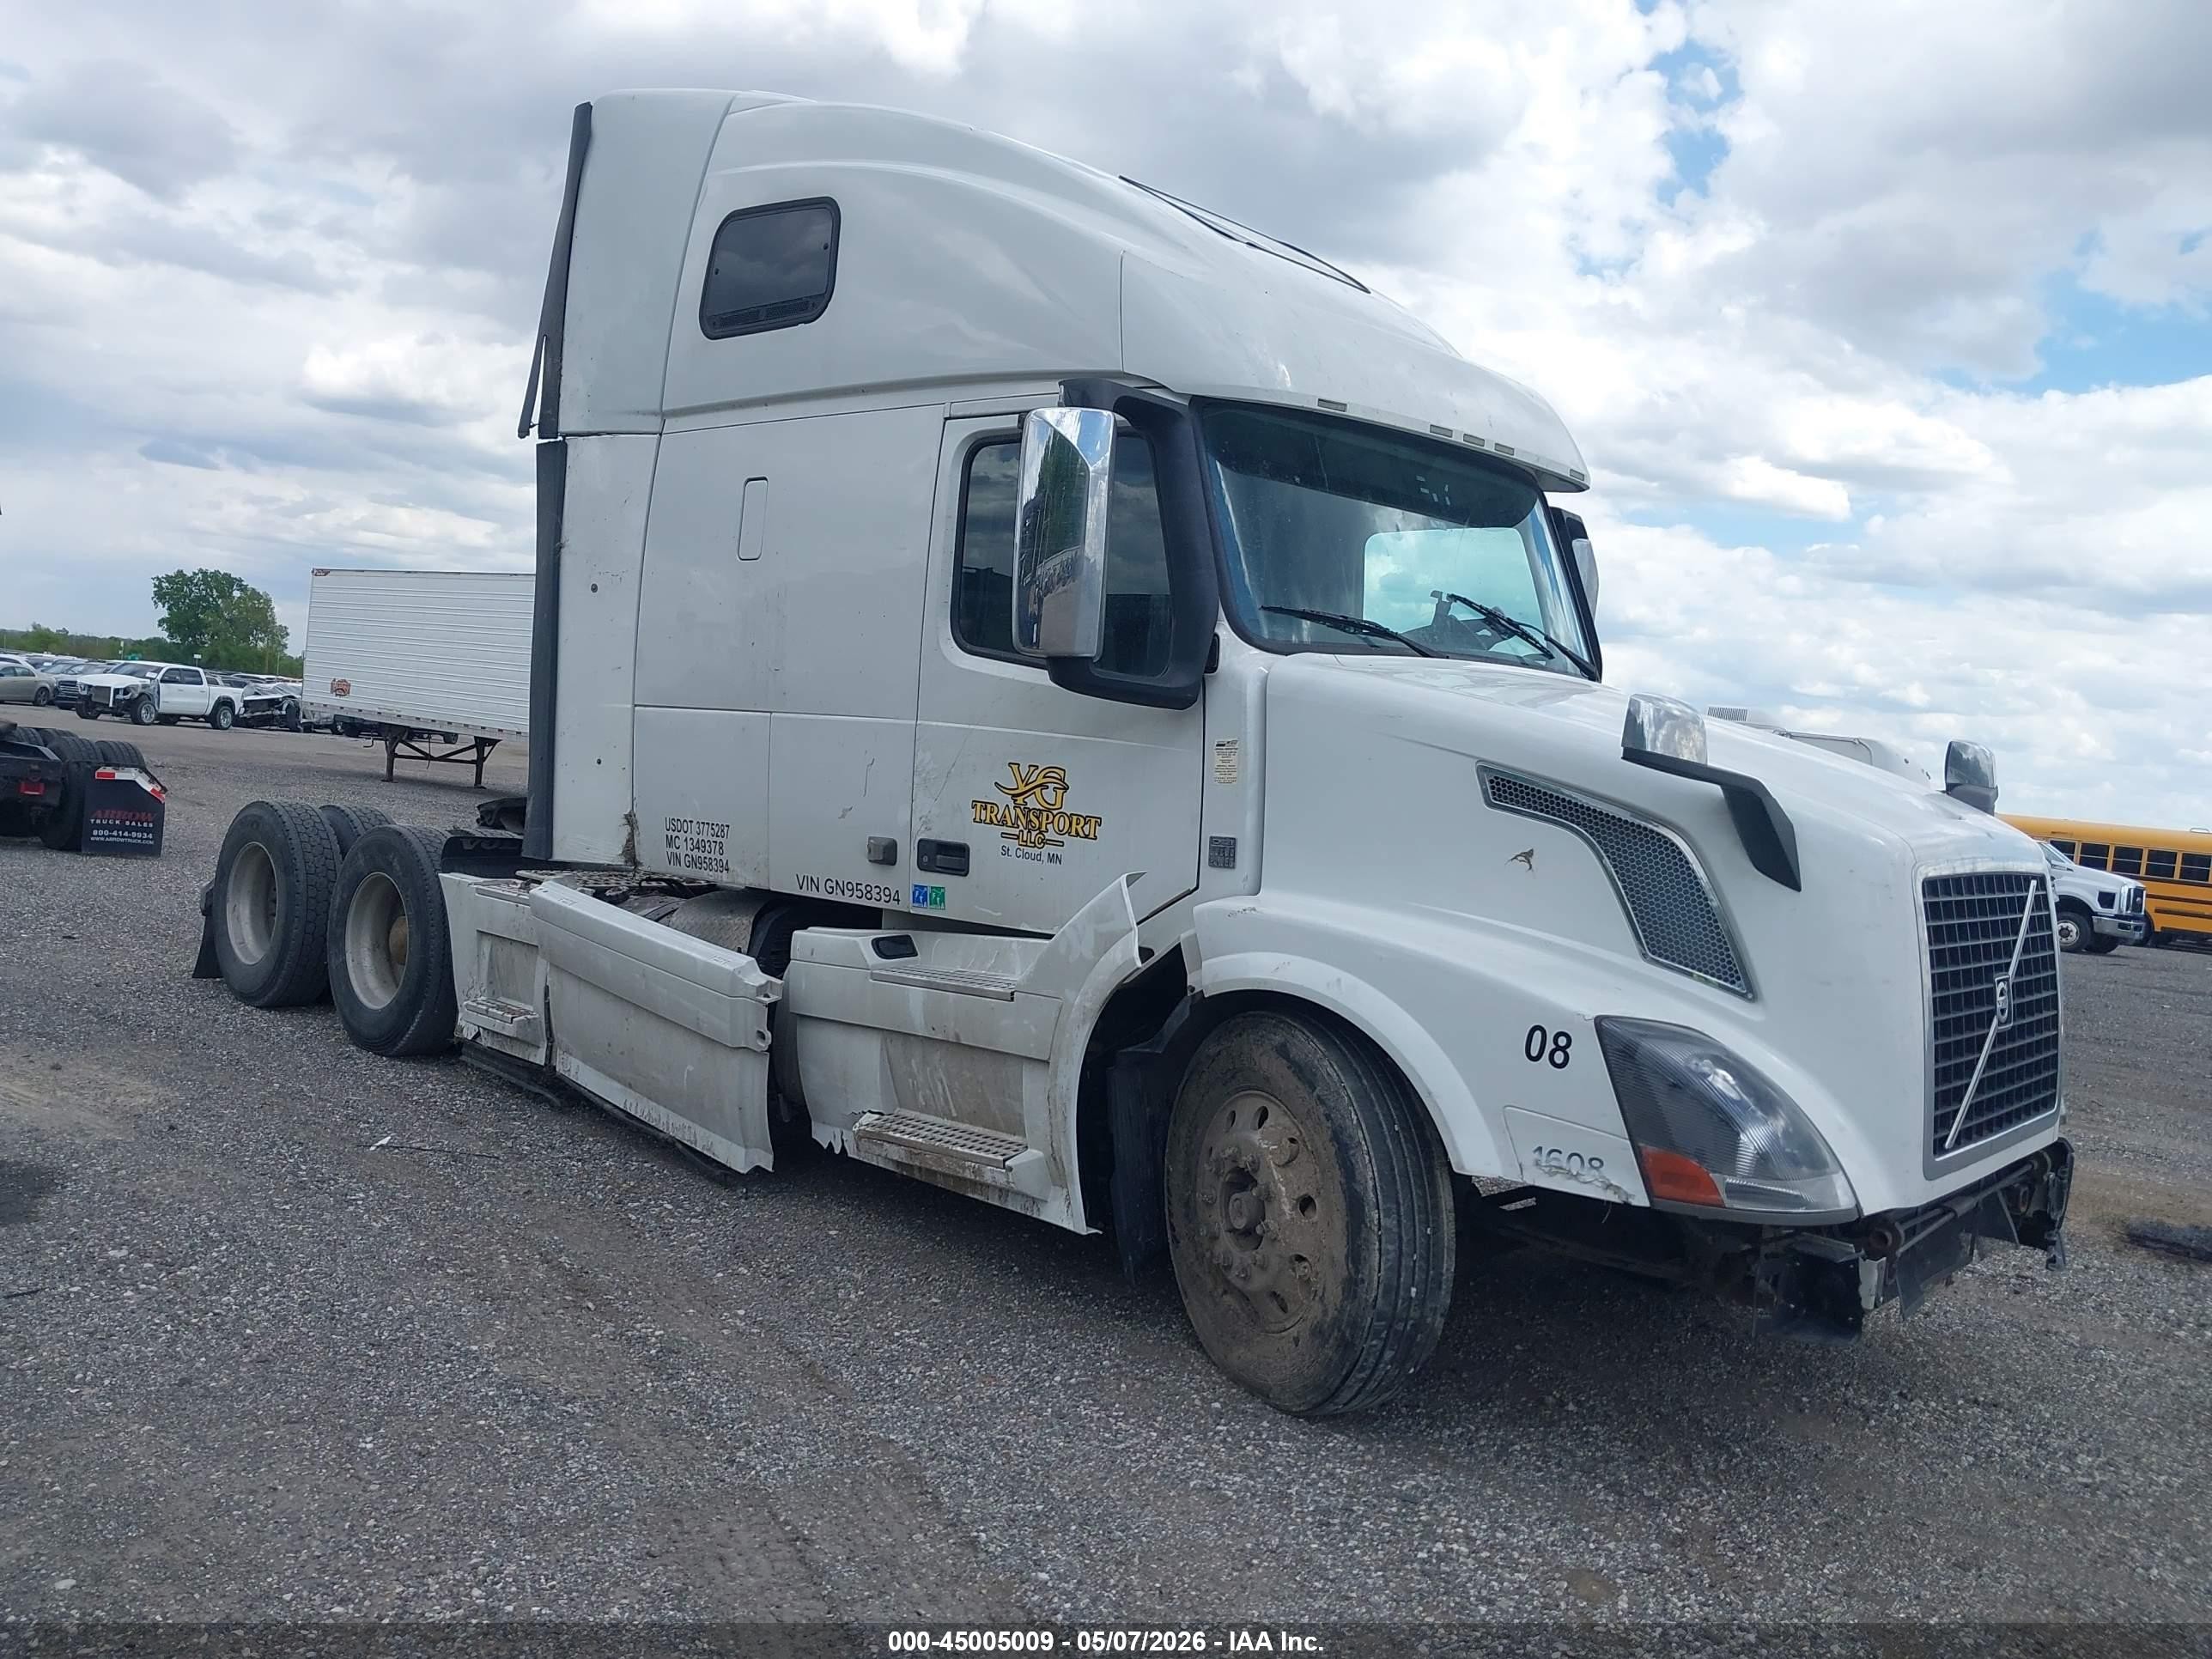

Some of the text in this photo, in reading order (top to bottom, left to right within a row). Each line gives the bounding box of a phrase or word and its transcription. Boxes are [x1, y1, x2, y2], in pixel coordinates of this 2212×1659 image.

[665, 817, 730, 839] USDOT 3775287
[972, 800, 1102, 840] TRANSPORT
[665, 835, 724, 856] MC 1349378
[1018, 830, 1046, 849] LLC
[666, 851, 730, 873] VIN GN958394
[1000, 845, 1063, 866] St. Cloud, MN
[795, 873, 901, 905] VIN GN958394
[1524, 1024, 1572, 1069] 08
